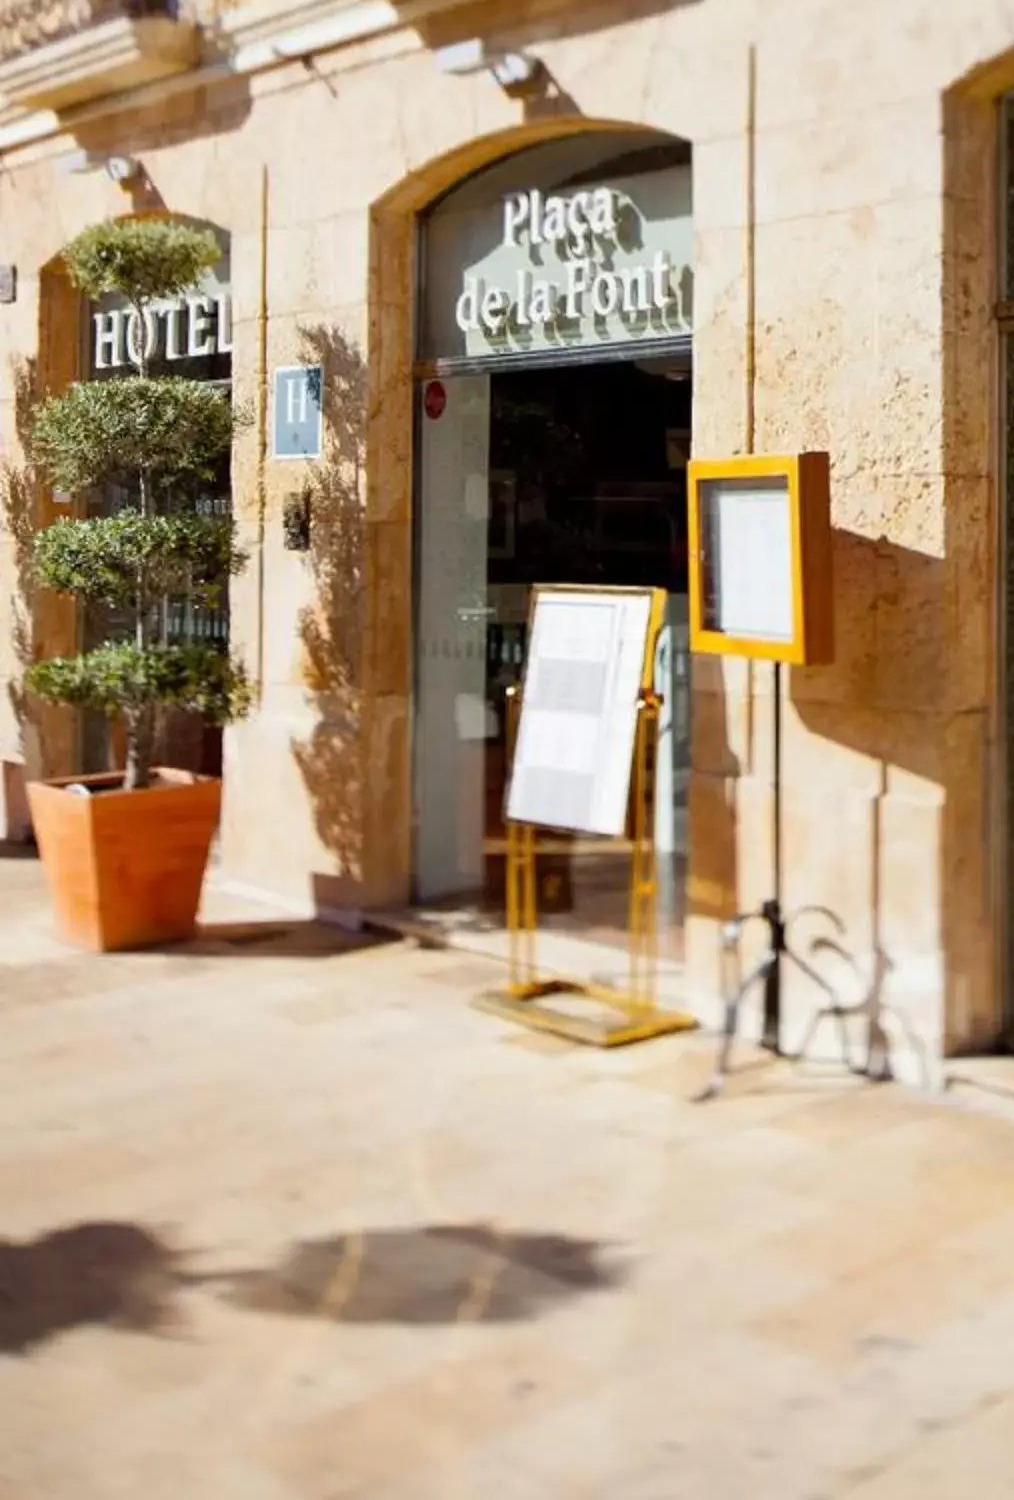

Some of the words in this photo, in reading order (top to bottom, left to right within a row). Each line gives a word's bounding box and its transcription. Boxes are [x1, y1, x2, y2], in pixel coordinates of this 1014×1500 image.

[503, 187, 616, 256] Plaça
[456, 276, 504, 333] de
[515, 269, 552, 325] la
[564, 250, 672, 319] Font
[93, 294, 232, 369] HOTEL
[285, 377, 308, 423] H
